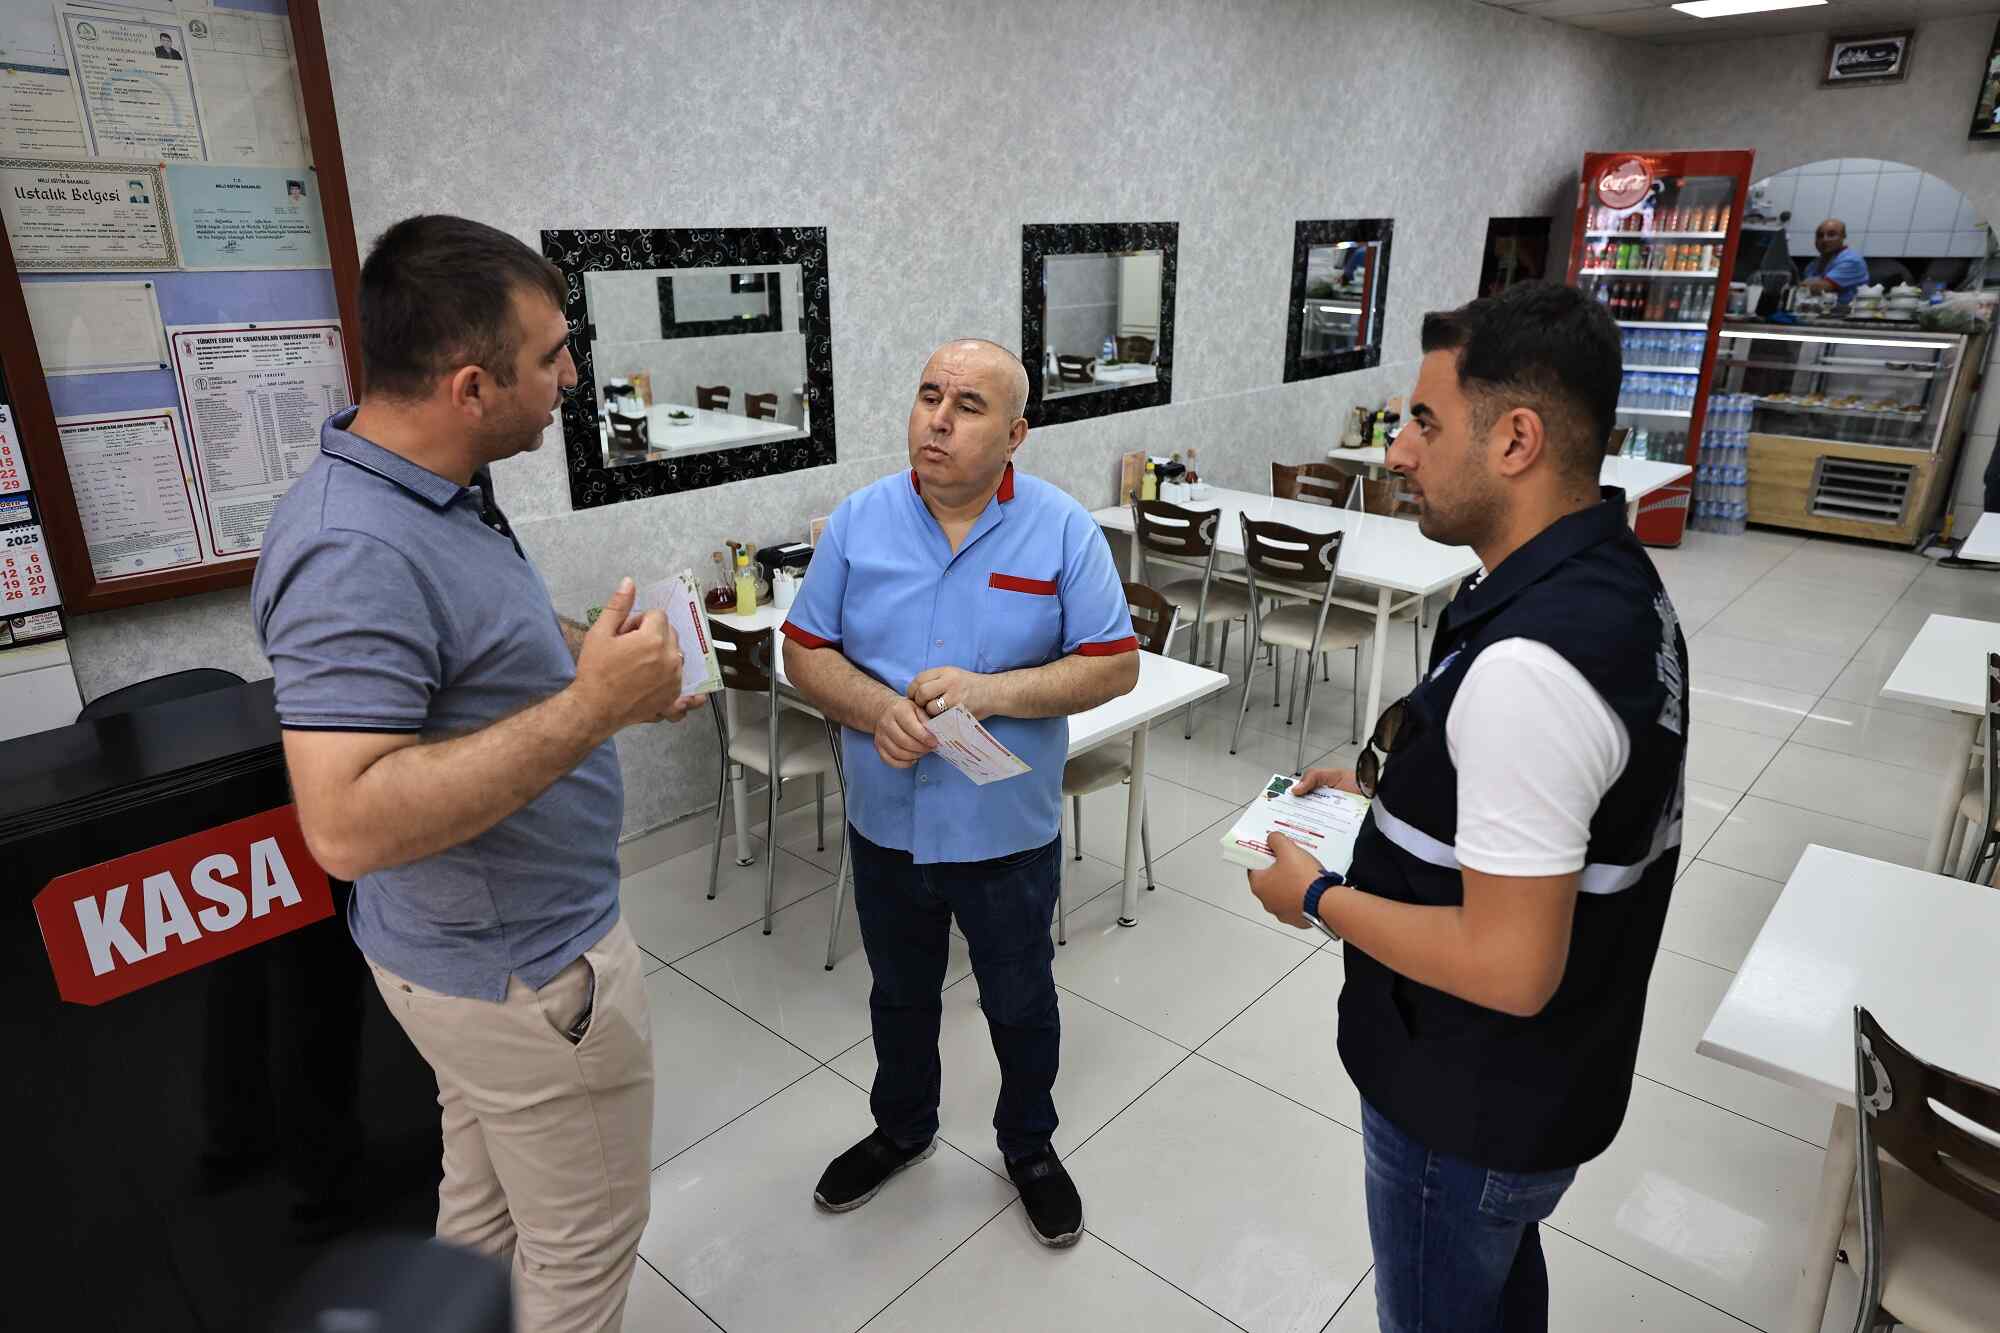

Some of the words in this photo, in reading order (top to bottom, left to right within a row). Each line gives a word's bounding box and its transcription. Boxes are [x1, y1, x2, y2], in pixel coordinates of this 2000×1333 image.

[14, 186, 67, 201] Ustalık
[71, 188, 121, 204] Belgesi
[2, 446, 10, 455] 8
[0, 469, 17, 478] 22
[3, 480, 20, 490] 29
[6, 534, 39, 547] 2025
[6, 558, 15, 567] 5
[31, 553, 39, 563] 6
[0, 569, 17, 579] 12
[25, 564, 42, 575] 13
[3, 580, 20, 590] 19
[28, 575, 45, 586] 20
[5, 591, 24, 601] 26
[31, 586, 47, 596] 27
[73, 836, 302, 977] KASA
